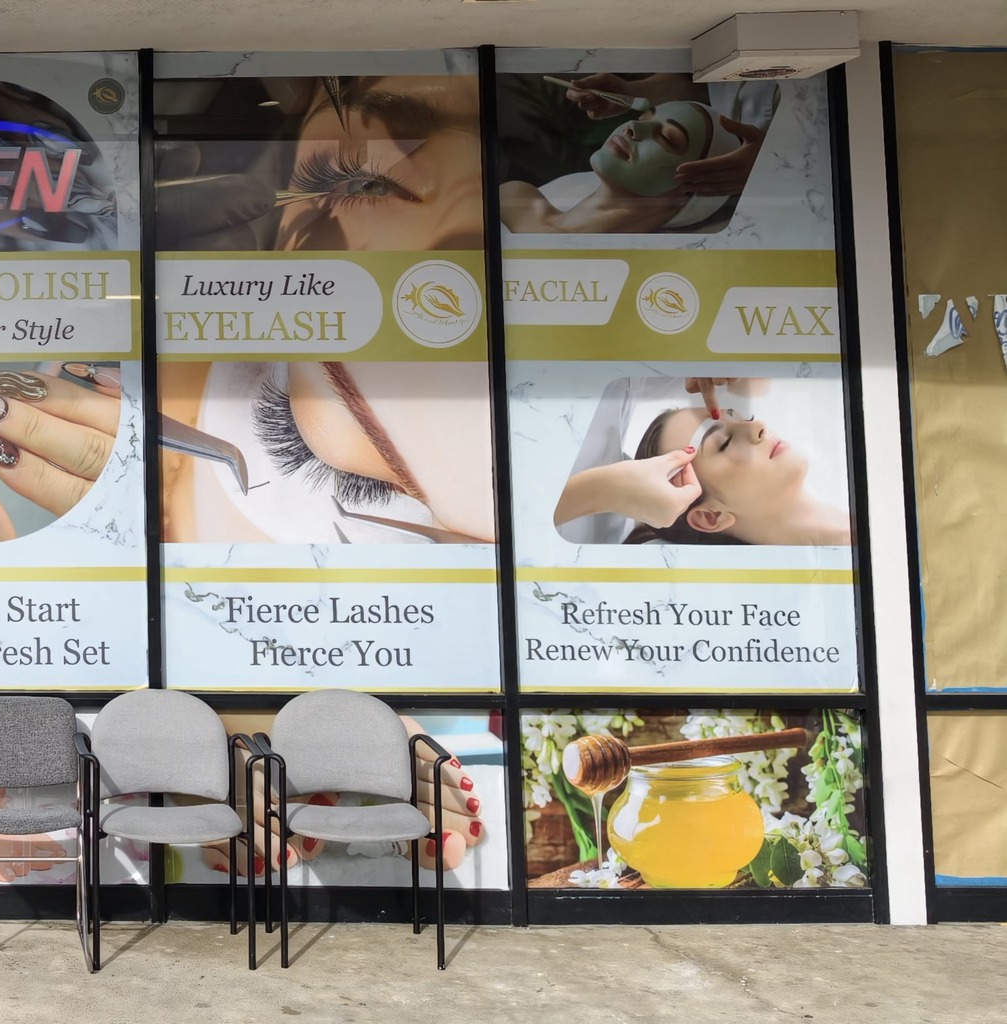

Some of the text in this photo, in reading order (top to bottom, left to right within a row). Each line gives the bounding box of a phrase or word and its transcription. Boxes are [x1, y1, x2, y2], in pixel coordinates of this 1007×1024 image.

[181, 273, 335, 302] Luxury Like
[503, 280, 609, 302] FACIAL
[11, 318, 75, 346] Style
[163, 311, 347, 341] EYELASH
[735, 306, 834, 336] WAX
[7, 596, 81, 623] Start
[225, 595, 435, 624] Fierce Lashes
[561, 601, 801, 627] Refresh Your Face
[62, 638, 110, 666] Set
[250, 638, 413, 667] Fierce You
[525, 638, 840, 663] Renew Your Confidence
